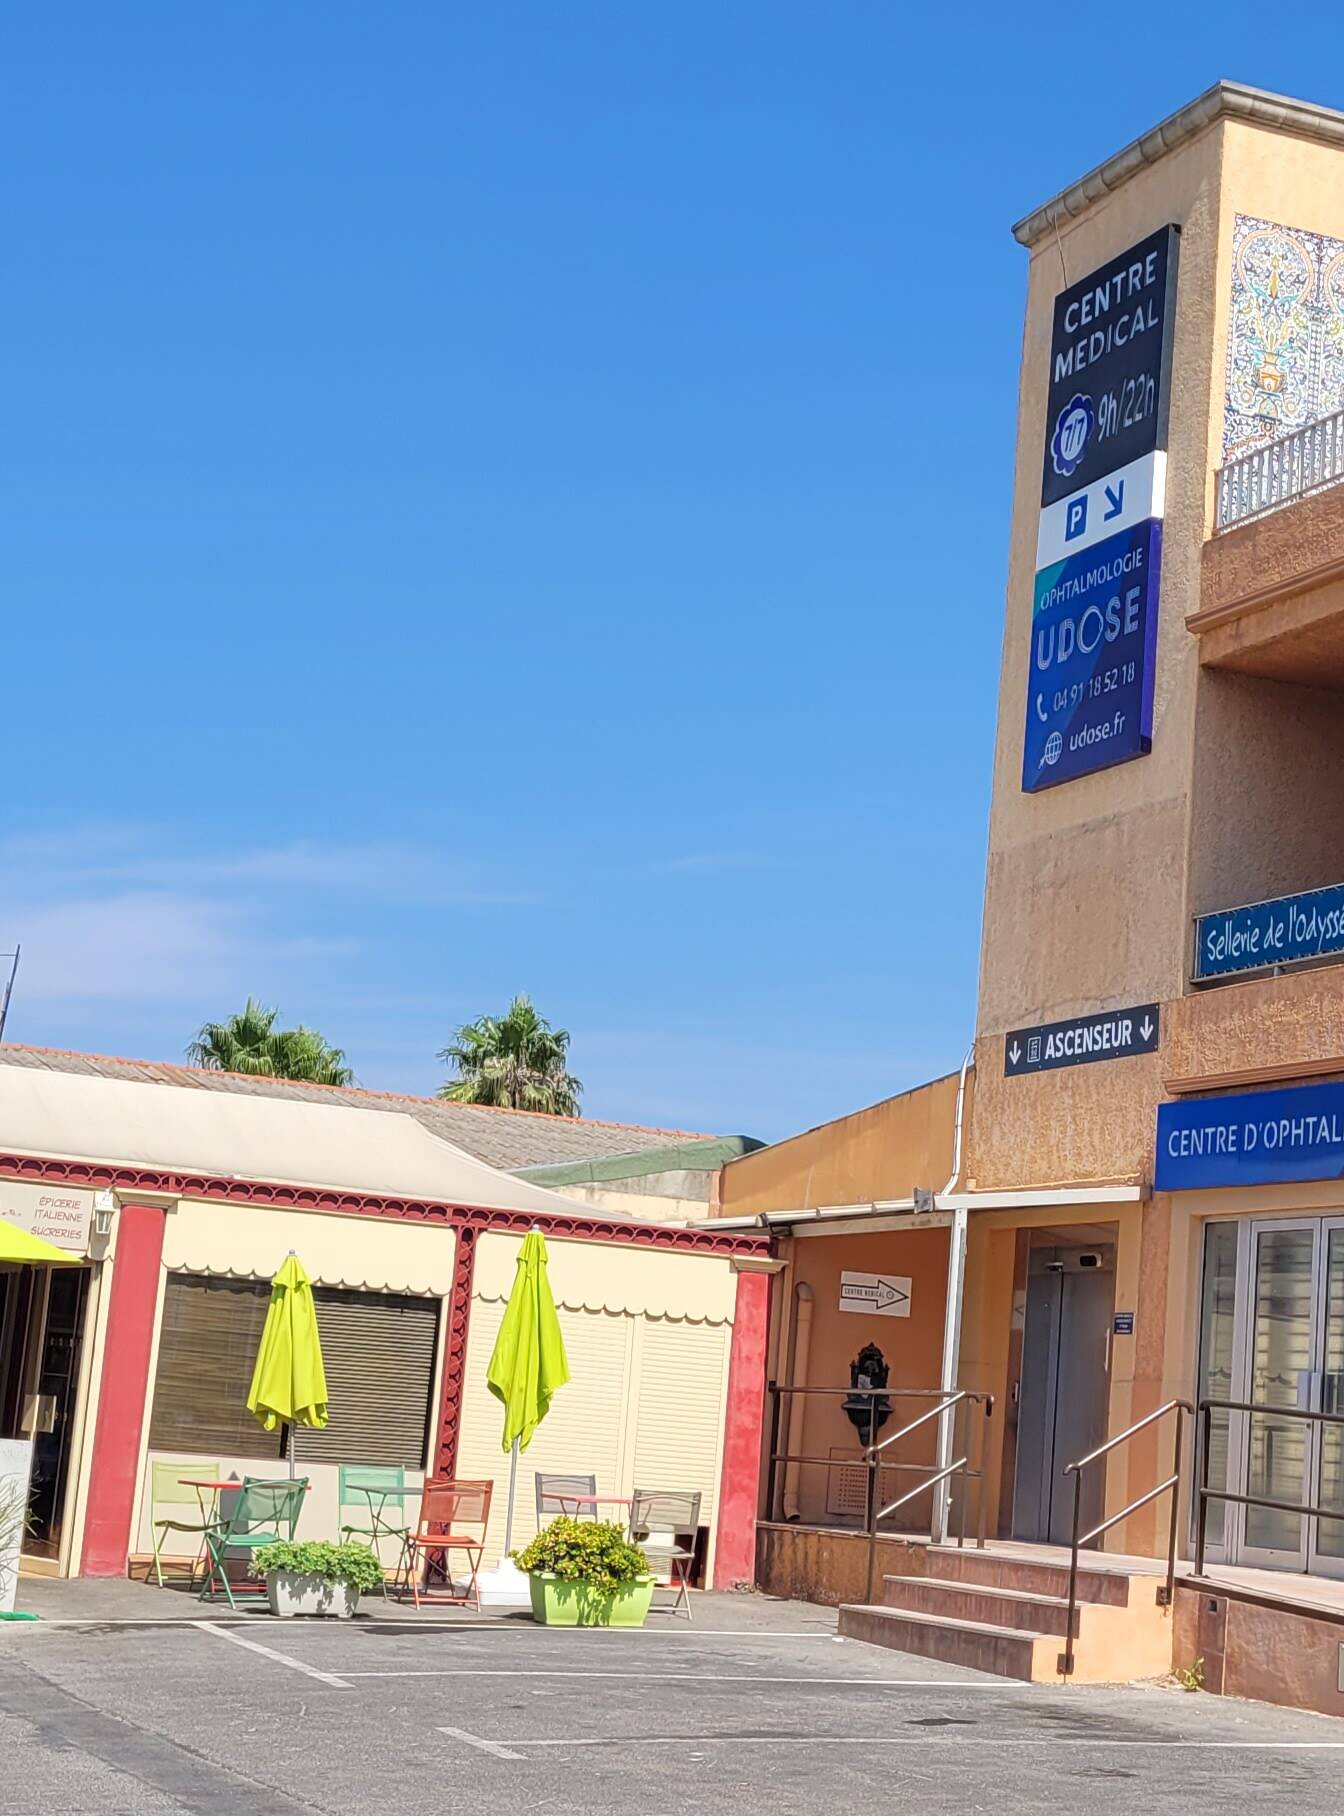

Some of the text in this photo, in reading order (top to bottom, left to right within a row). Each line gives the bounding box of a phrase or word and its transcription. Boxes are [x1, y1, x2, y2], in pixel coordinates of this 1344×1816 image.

[1064, 251, 1158, 334] CENTRE
[1054, 297, 1159, 384] MEDICAL
[1064, 372, 1155, 453] 7/7 9h/22h
[1070, 504, 1083, 533] P
[1040, 547, 1144, 611] OPHTALMOLOGIE
[1037, 585, 1141, 671] UDOSE
[1053, 661, 1135, 713] 04 91 18 52 18
[1069, 710, 1126, 752] udose.fr
[1207, 920, 1259, 961] Sellerie
[1264, 920, 1283, 949] de
[1044, 1019, 1132, 1060] ASCENSEUR
[1168, 1125, 1238, 1157] CENTRE
[31, 1226, 82, 1239] SUCRERIES
[35, 1209, 83, 1222] ITALIENNE
[844, 1287, 863, 1296] CENTRE
